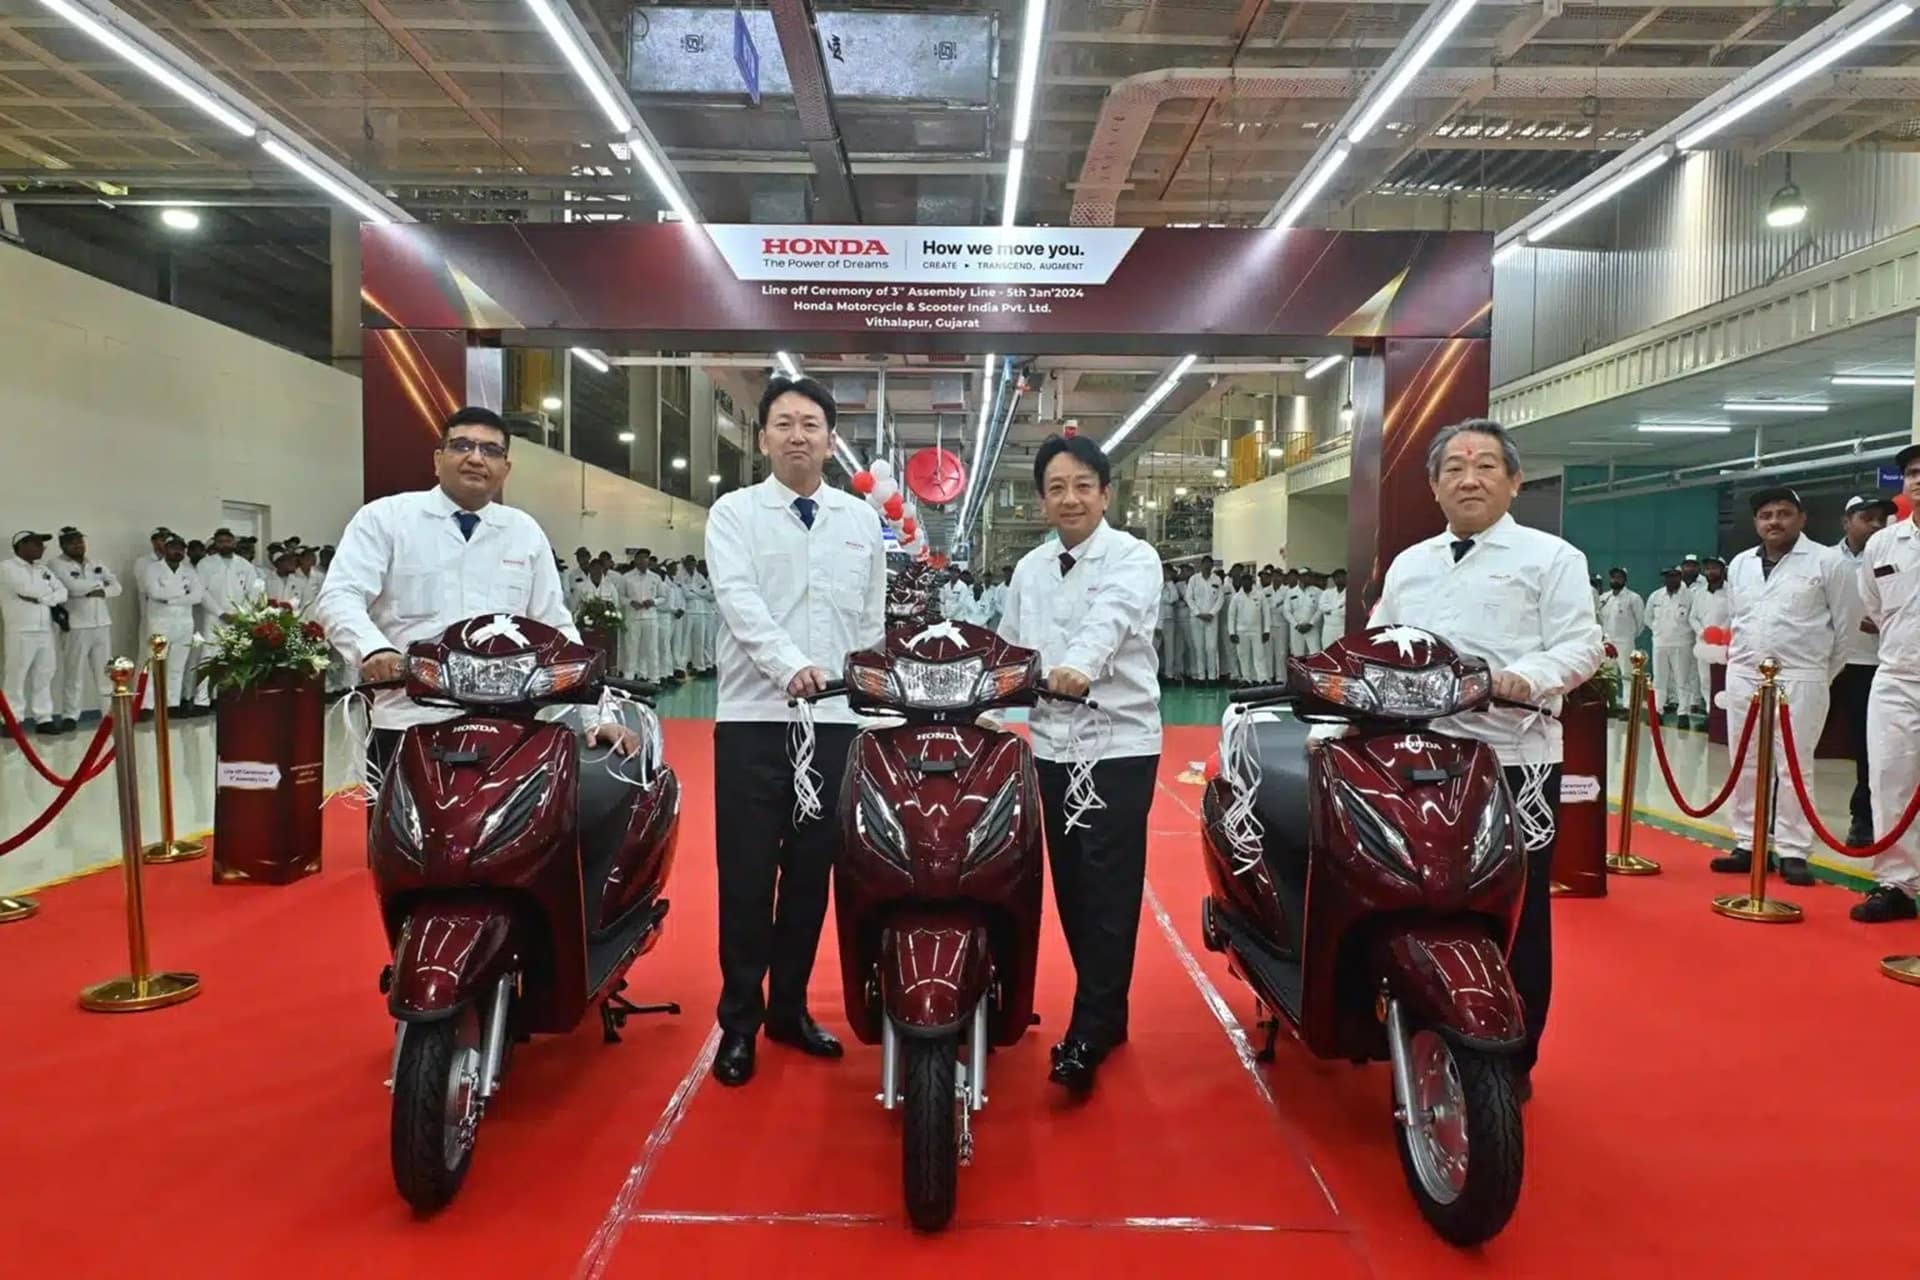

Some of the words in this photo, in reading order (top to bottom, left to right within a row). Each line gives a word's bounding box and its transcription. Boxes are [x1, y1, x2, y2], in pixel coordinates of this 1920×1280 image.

[762, 238, 889, 255] HONDA
[922, 240, 963, 255] How
[967, 244, 993, 255] we
[997, 244, 1045, 256] move
[1048, 244, 1085, 259] you.
[763, 258, 785, 268] The
[788, 258, 824, 268] Power
[827, 258, 840, 268] of
[843, 259, 889, 269] Dreams
[922, 261, 957, 270] CREATE
[1039, 262, 1084, 270] AUGMENT
[761, 285, 788, 295] Line
[791, 285, 808, 295] off
[811, 285, 873, 298] Ceremony
[875, 286, 888, 296] of
[908, 286, 967, 298] Assembly
[970, 287, 996, 297] Line
[1006, 287, 1026, 297] 5th
[1029, 287, 1084, 298] Jan'2024
[793, 301, 833, 311] Honda
[836, 301, 903, 313] Motorcycle
[906, 302, 915, 312] &
[917, 302, 964, 312] Scooter
[967, 302, 998, 313] India
[1001, 303, 1025, 313] Pvt.
[1028, 303, 1052, 313] Ltd.
[865, 317, 933, 329] Vithalapur,
[935, 318, 980, 330] Gujarat
[452, 724, 500, 734] HONDA
